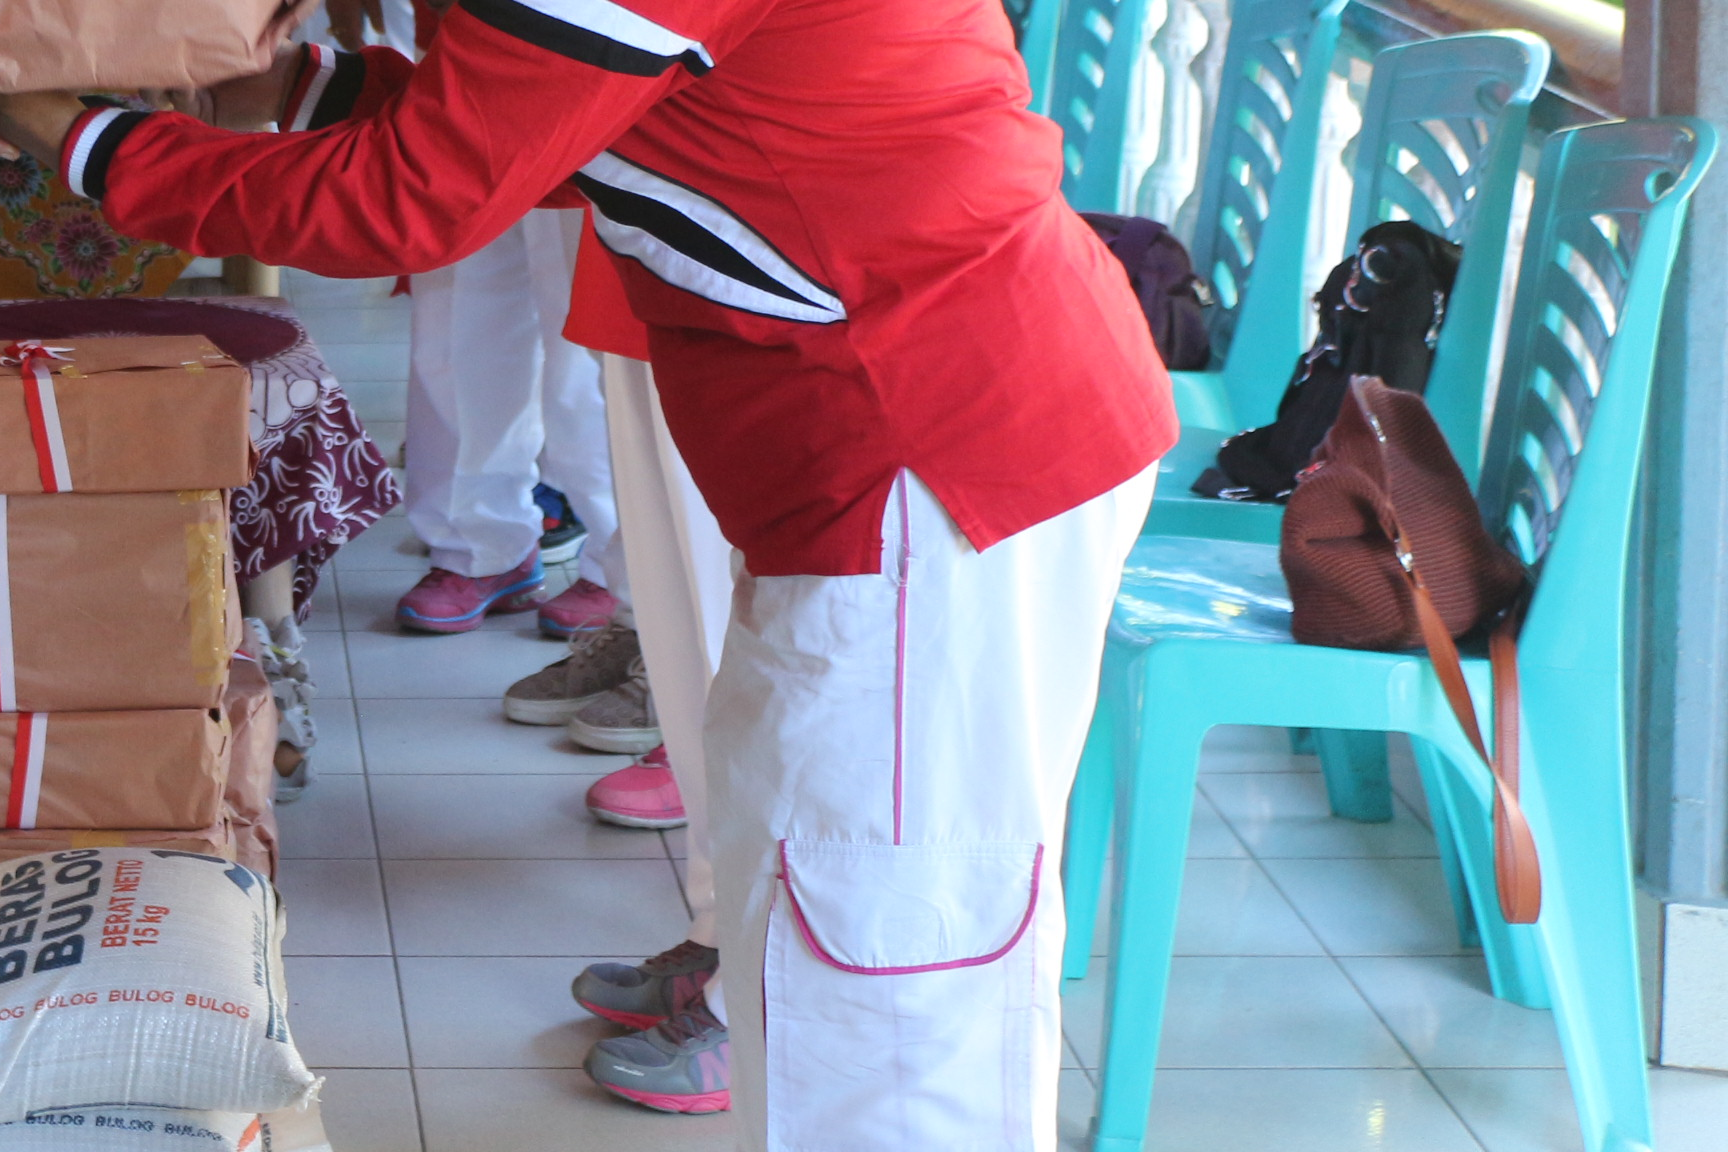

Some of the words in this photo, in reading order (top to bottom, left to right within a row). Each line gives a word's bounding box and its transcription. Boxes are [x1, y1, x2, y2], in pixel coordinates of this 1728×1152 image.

[113, 859, 144, 893] NETTO
[33, 849, 103, 974] BULOG
[101, 896, 137, 948] BERAT
[136, 904, 171, 924] kg
[132, 928, 161, 946] 15
[33, 991, 98, 1012] BULOG
[108, 989, 175, 1004] BULOG
[185, 993, 251, 1019] BULOG
[25, 1112, 85, 1126] BULOG
[95, 1114, 155, 1132] BULOG
